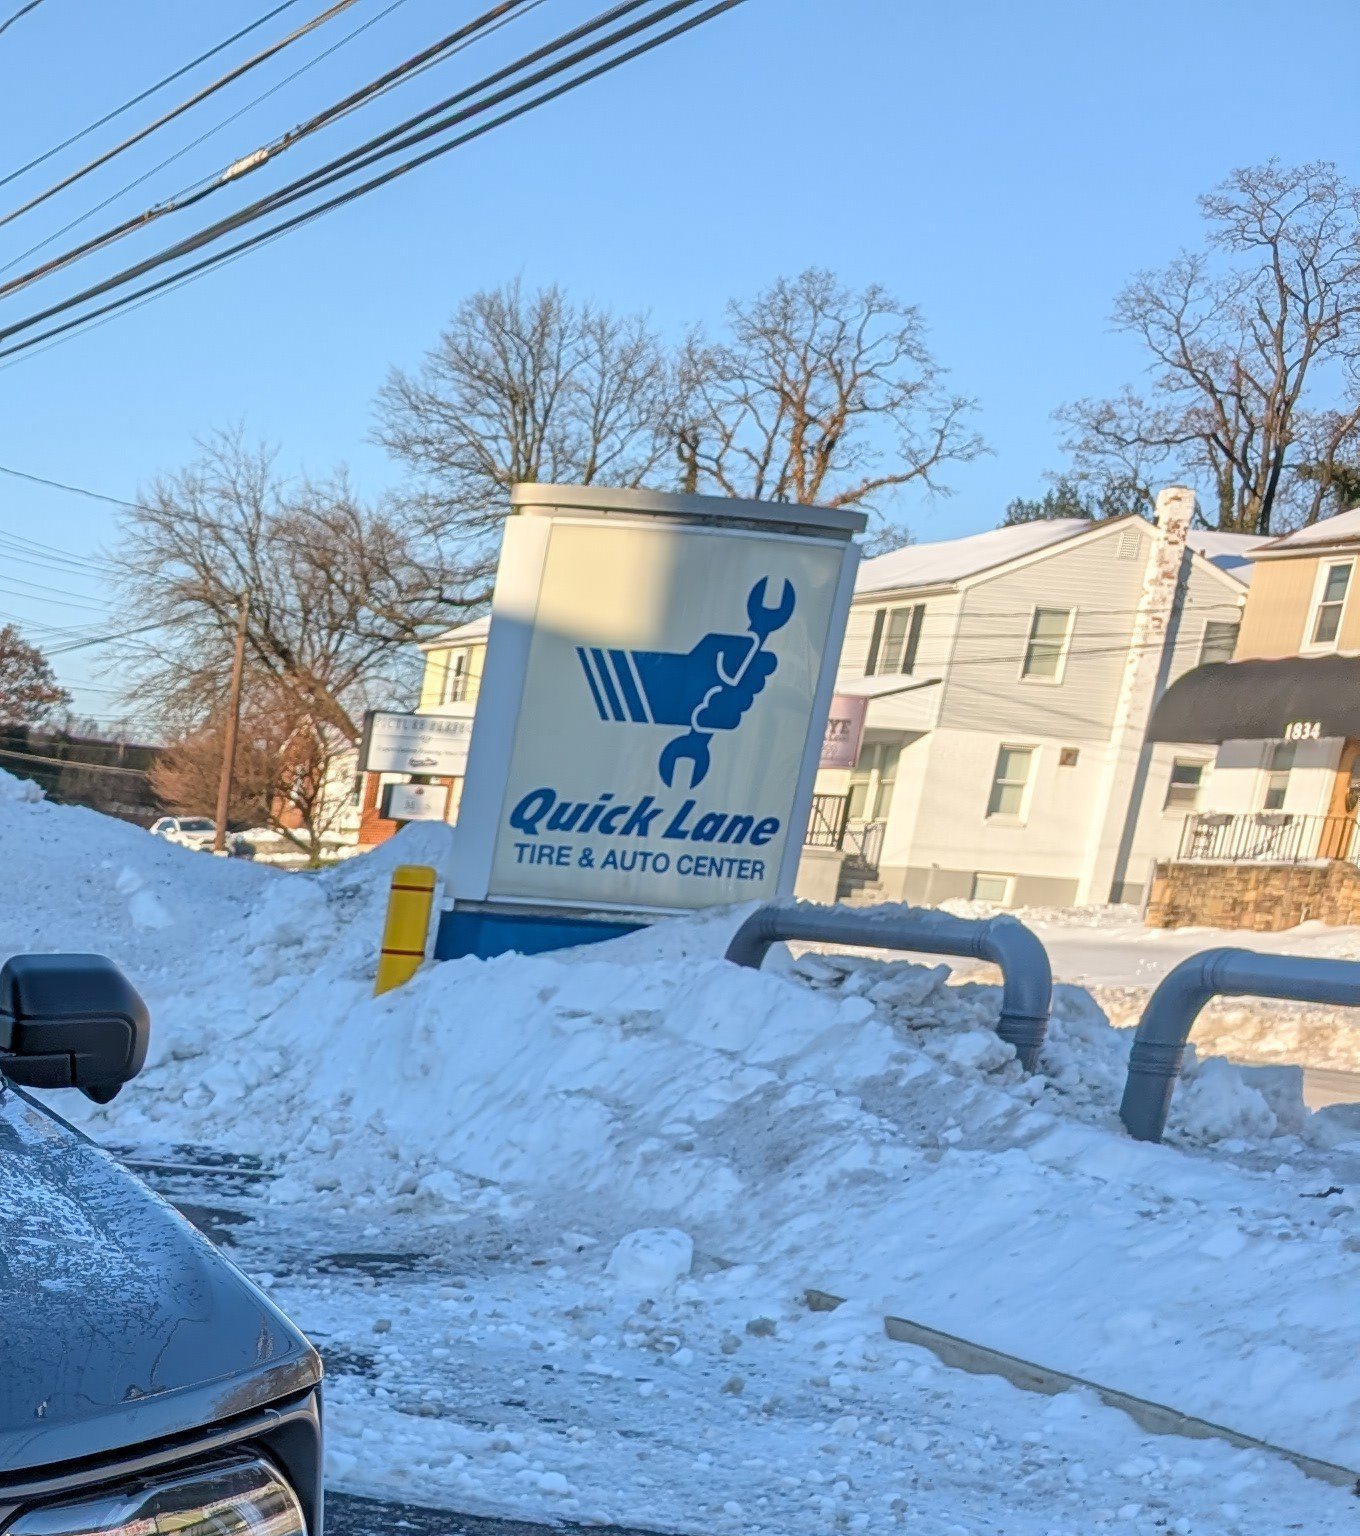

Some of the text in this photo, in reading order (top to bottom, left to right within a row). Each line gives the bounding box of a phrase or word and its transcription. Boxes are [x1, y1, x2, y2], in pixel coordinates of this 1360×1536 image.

[1284, 721, 1322, 741] 1834
[508, 786, 781, 847] Quick Lane
[514, 842, 766, 881] TIRE & AUTO CENTER
